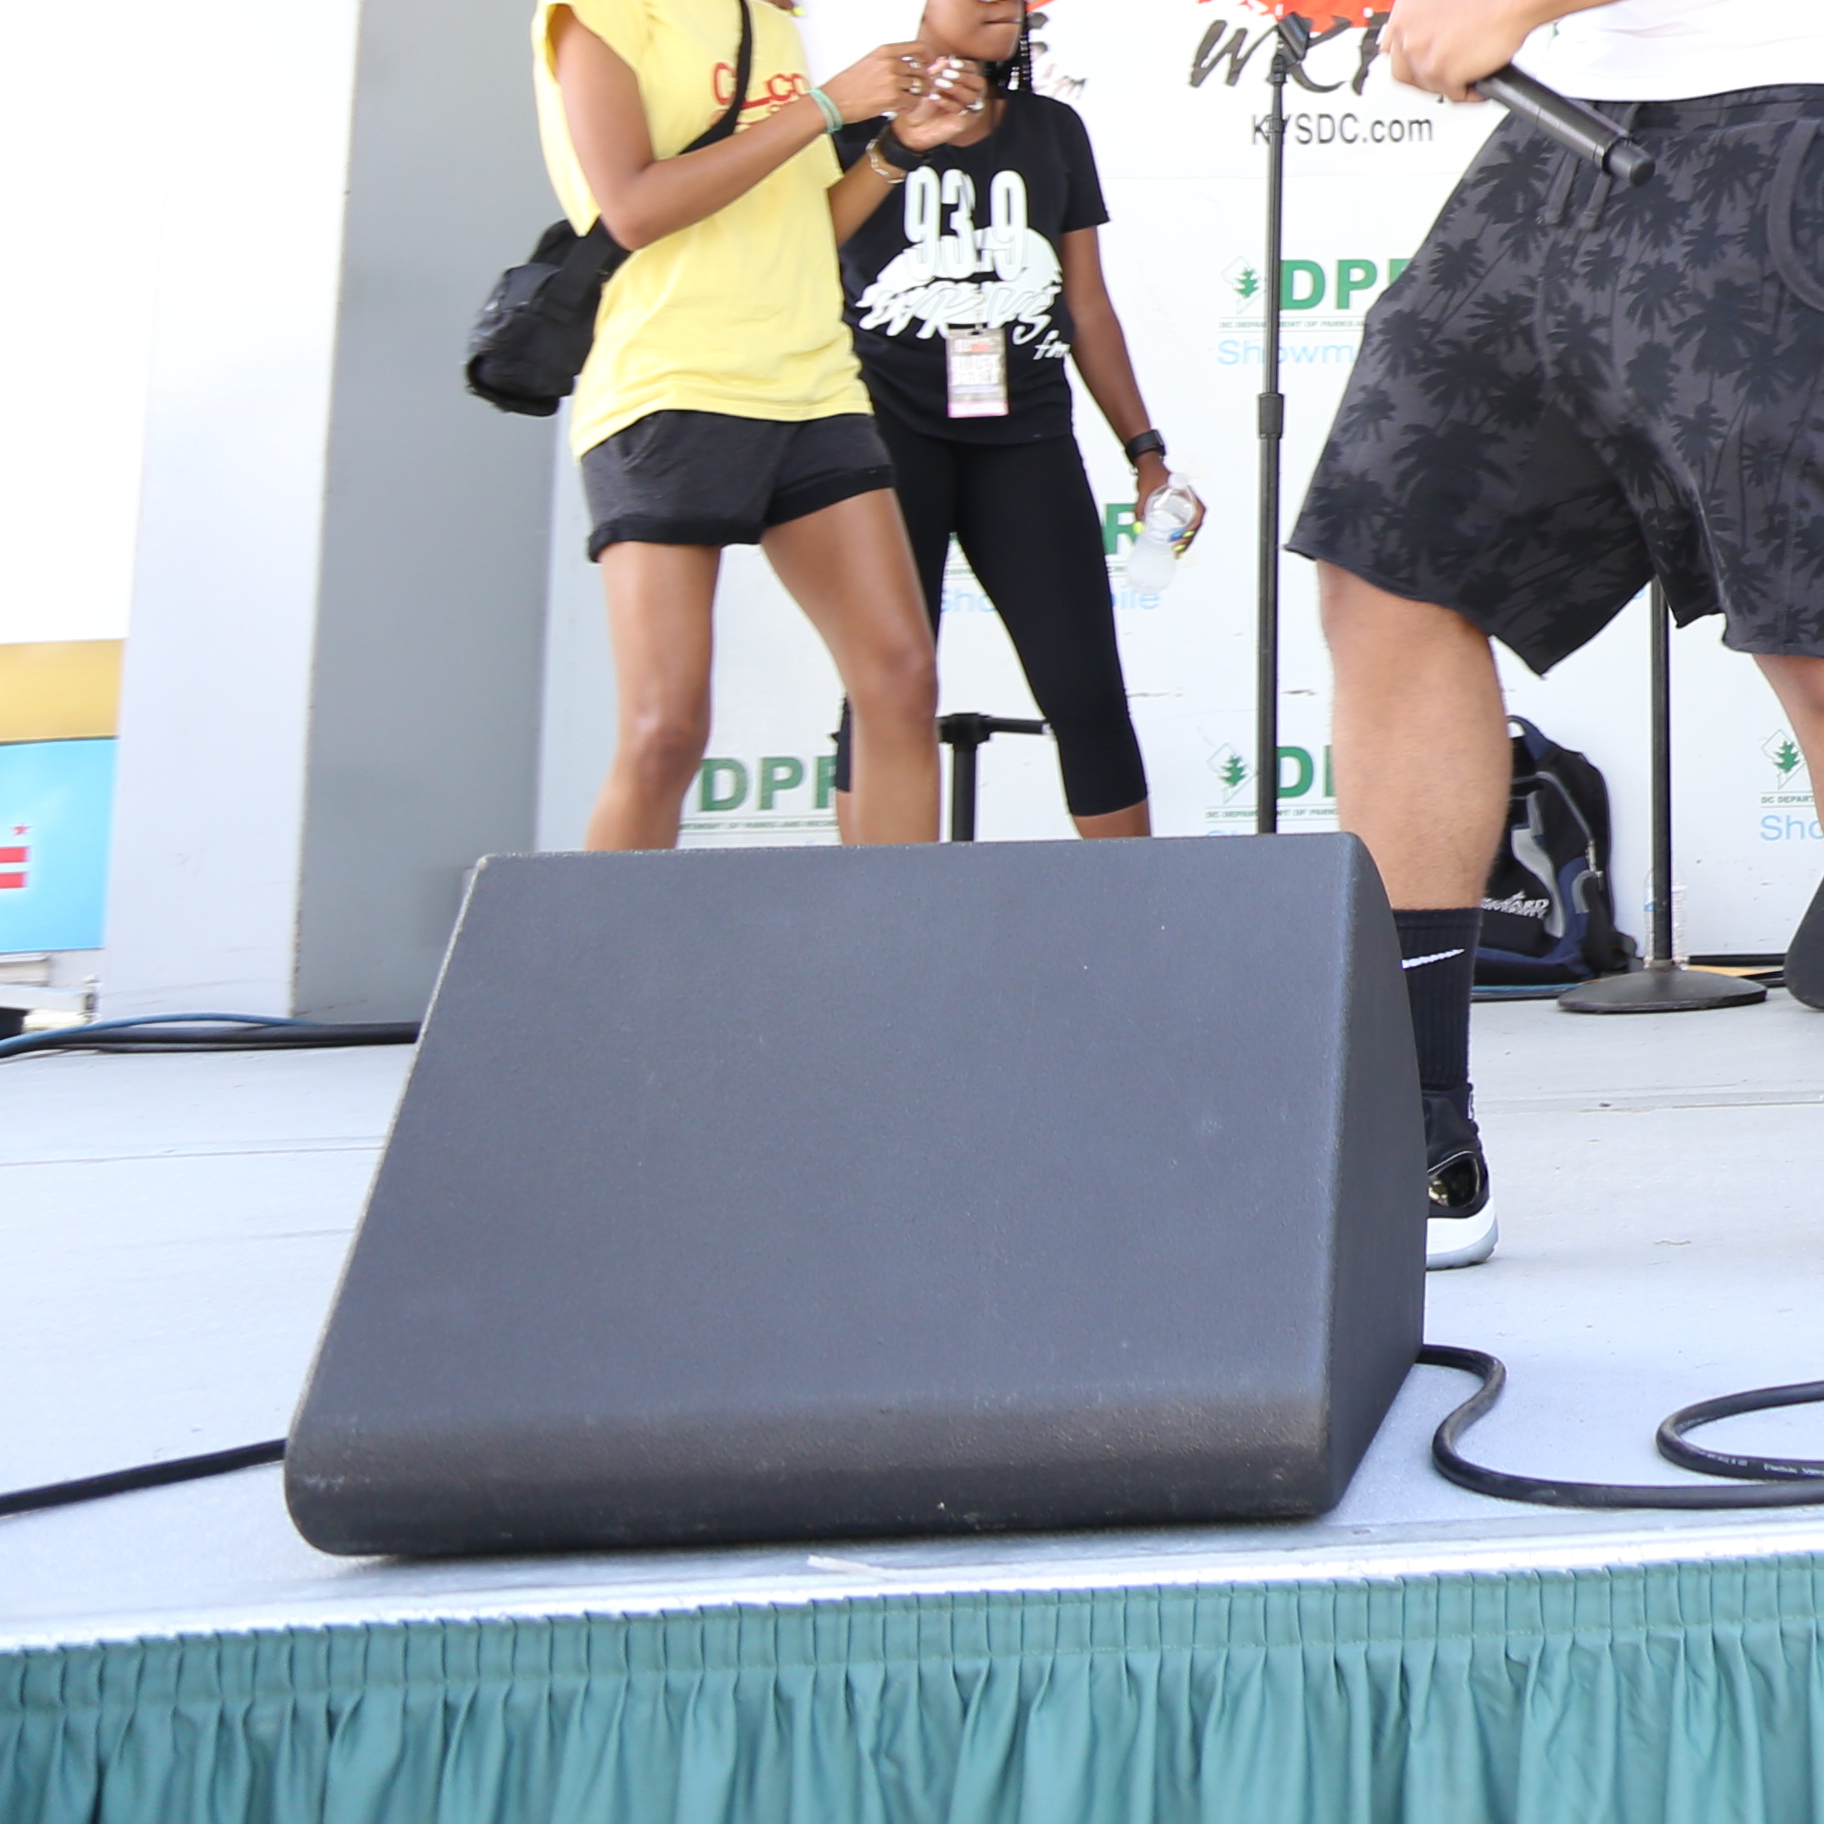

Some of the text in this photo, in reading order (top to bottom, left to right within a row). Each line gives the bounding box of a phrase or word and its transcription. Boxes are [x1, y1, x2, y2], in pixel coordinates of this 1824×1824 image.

[1251, 113, 1433, 146] KYSDC.com
[904, 166, 1028, 282] 93.9
[1032, 329, 1072, 360] fm
[1761, 796, 1774, 804] DC
